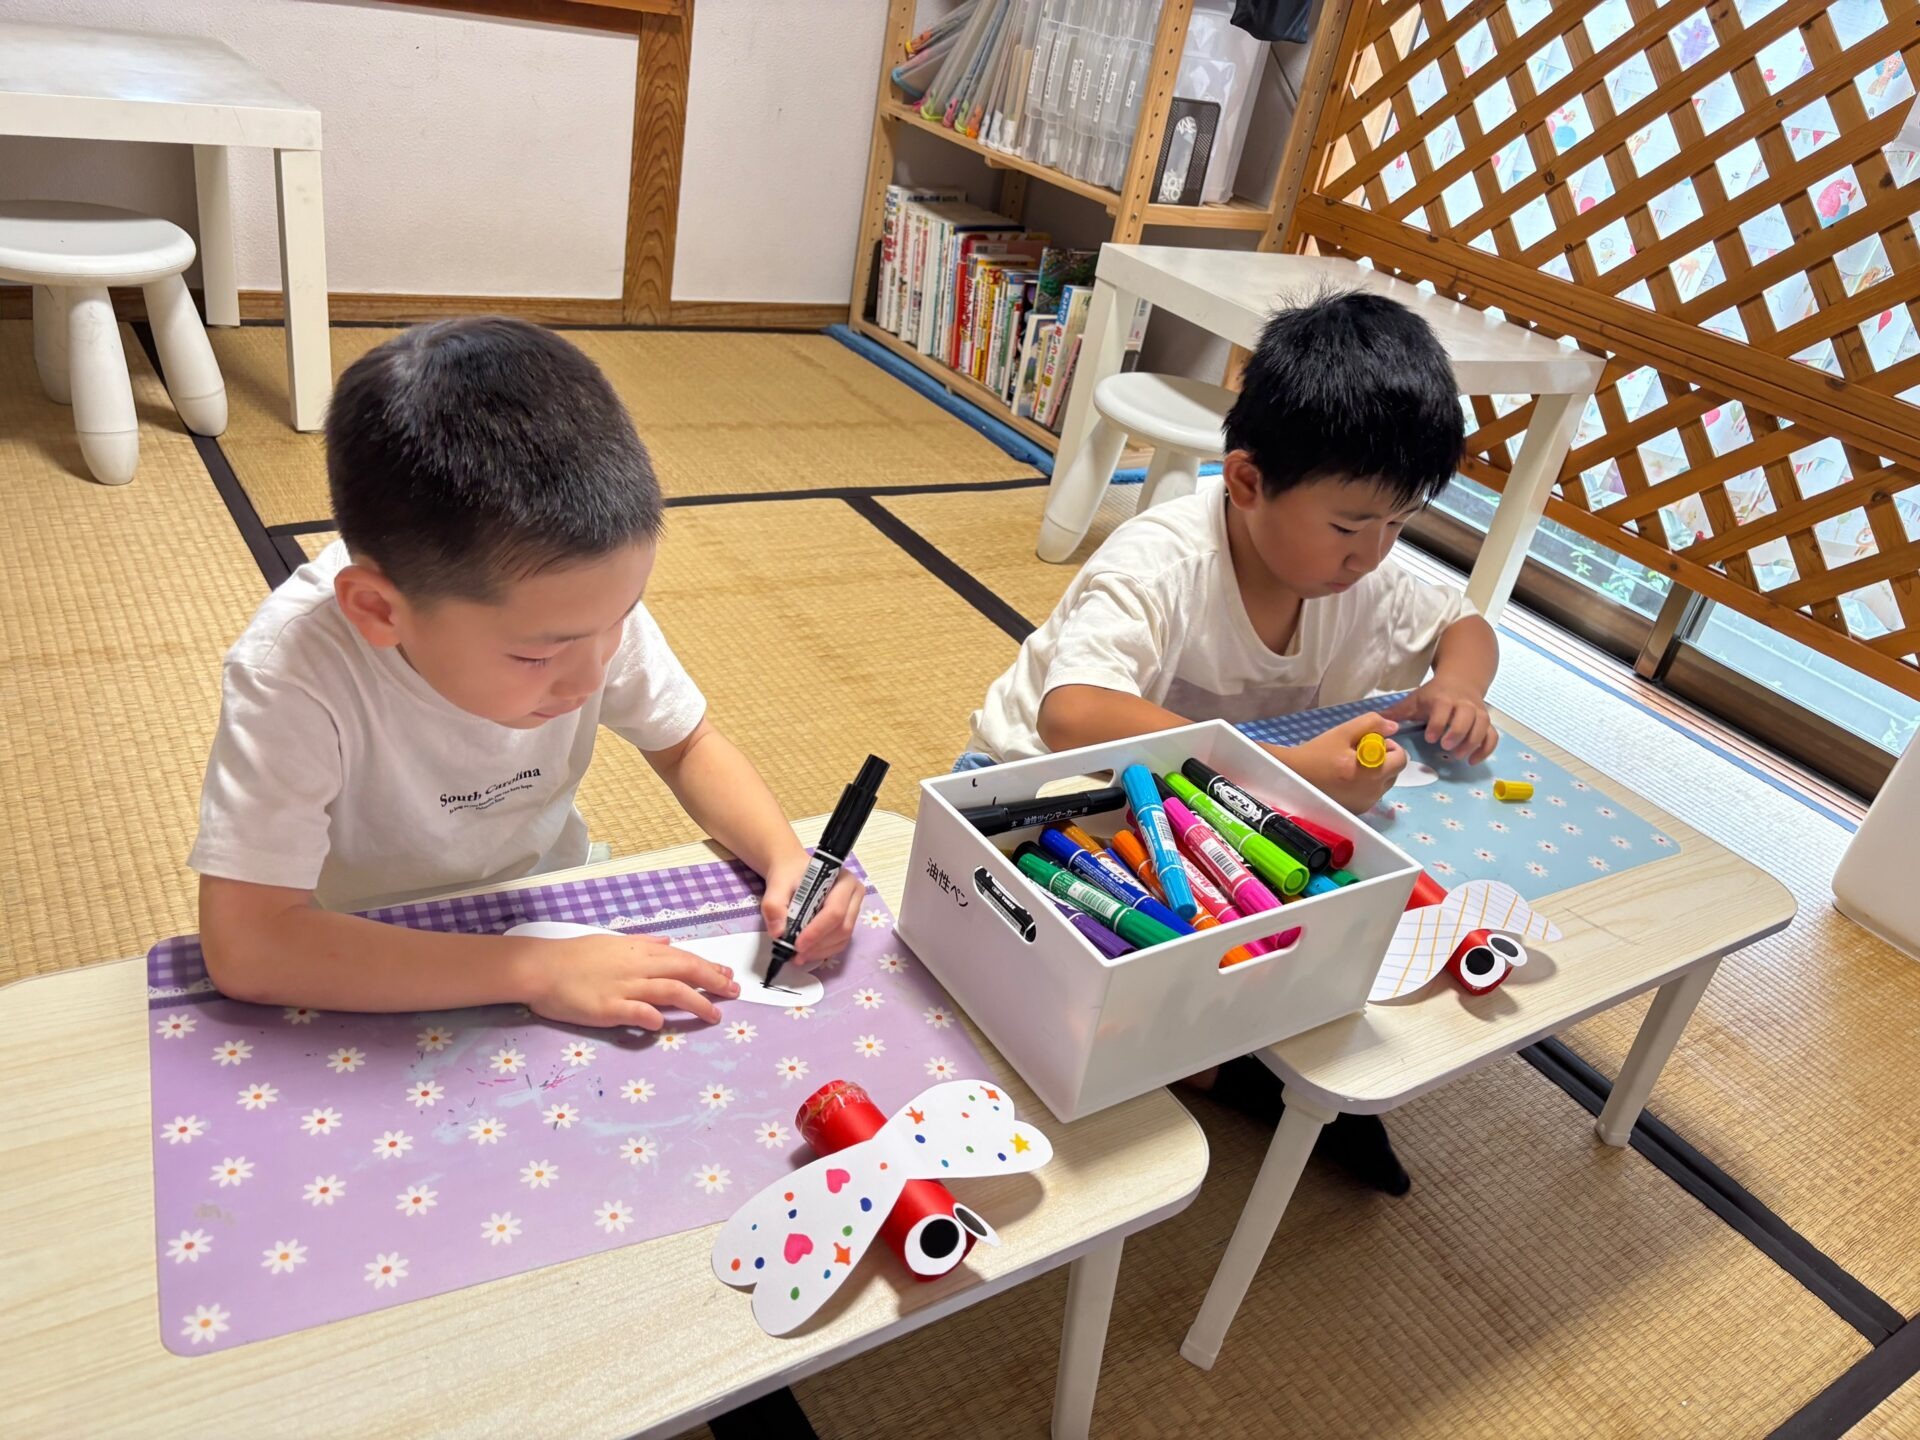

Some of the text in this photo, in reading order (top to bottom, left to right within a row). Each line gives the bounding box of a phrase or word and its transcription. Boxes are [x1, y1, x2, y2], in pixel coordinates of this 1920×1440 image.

[439, 791, 482, 808] South
[485, 768, 541, 795] Carolina
[1225, 790, 1250, 812] マッキー
[926, 857, 969, 907] 油性ペン
